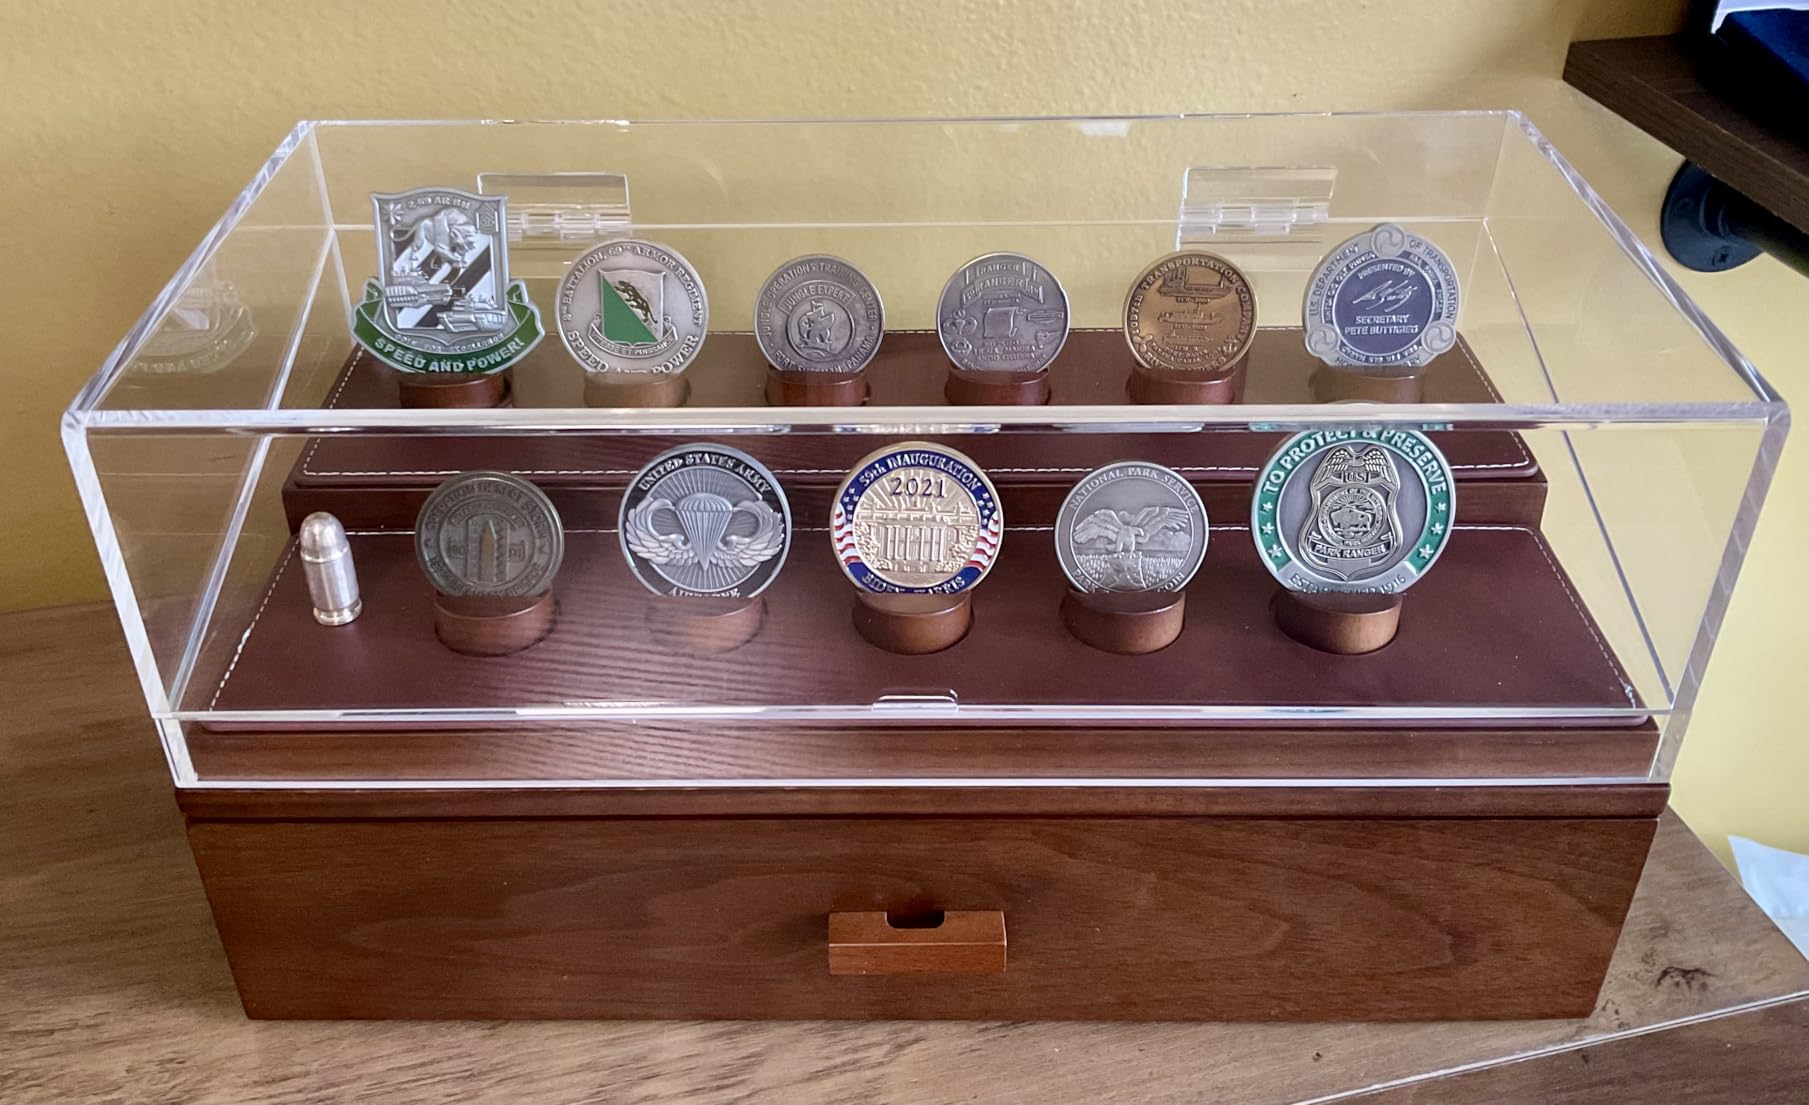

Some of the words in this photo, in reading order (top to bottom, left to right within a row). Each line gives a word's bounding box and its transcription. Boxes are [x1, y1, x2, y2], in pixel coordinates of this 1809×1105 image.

[632, 246, 676, 269] ARMOR
[676, 267, 703, 327] REGIMENT
[766, 263, 816, 299] OPERATIONS
[1141, 257, 1239, 290] TRANSPORTATION
[1313, 243, 1360, 296] DEPARTMENT
[1409, 239, 1423, 249] OF
[1424, 245, 1456, 320] TRANSPORTATION
[1357, 262, 1403, 280] PRESENTED
[1403, 267, 1417, 277] BY
[784, 285, 816, 311] JUNGLE
[817, 284, 851, 304] EXPERT
[1344, 325, 1369, 336] PETE
[1370, 324, 1419, 336] BUTTIGIEG
[1355, 313, 1410, 325] SECRETARY
[374, 338, 427, 369] SPEED
[428, 359, 465, 373] AND
[466, 337, 525, 370] POWER!
[567, 329, 609, 373] SPEED
[651, 334, 700, 374] POWER
[846, 335, 876, 370] PANAMA
[638, 457, 684, 491] UNITED
[685, 453, 736, 469] STATES
[735, 463, 772, 492] ARMY
[859, 463, 887, 487] 59th
[887, 453, 982, 491] INAUGURATION
[1263, 470, 1285, 494] TO
[1380, 430, 1448, 495] PRESERVE
[890, 477, 948, 498] 2021
[1069, 469, 1124, 511] NATIONAL
[1128, 466, 1159, 480] PARK
[1161, 475, 1200, 514] SERVICE
[1314, 543, 1342, 557] PARK
[1342, 544, 1386, 559] RANGER
